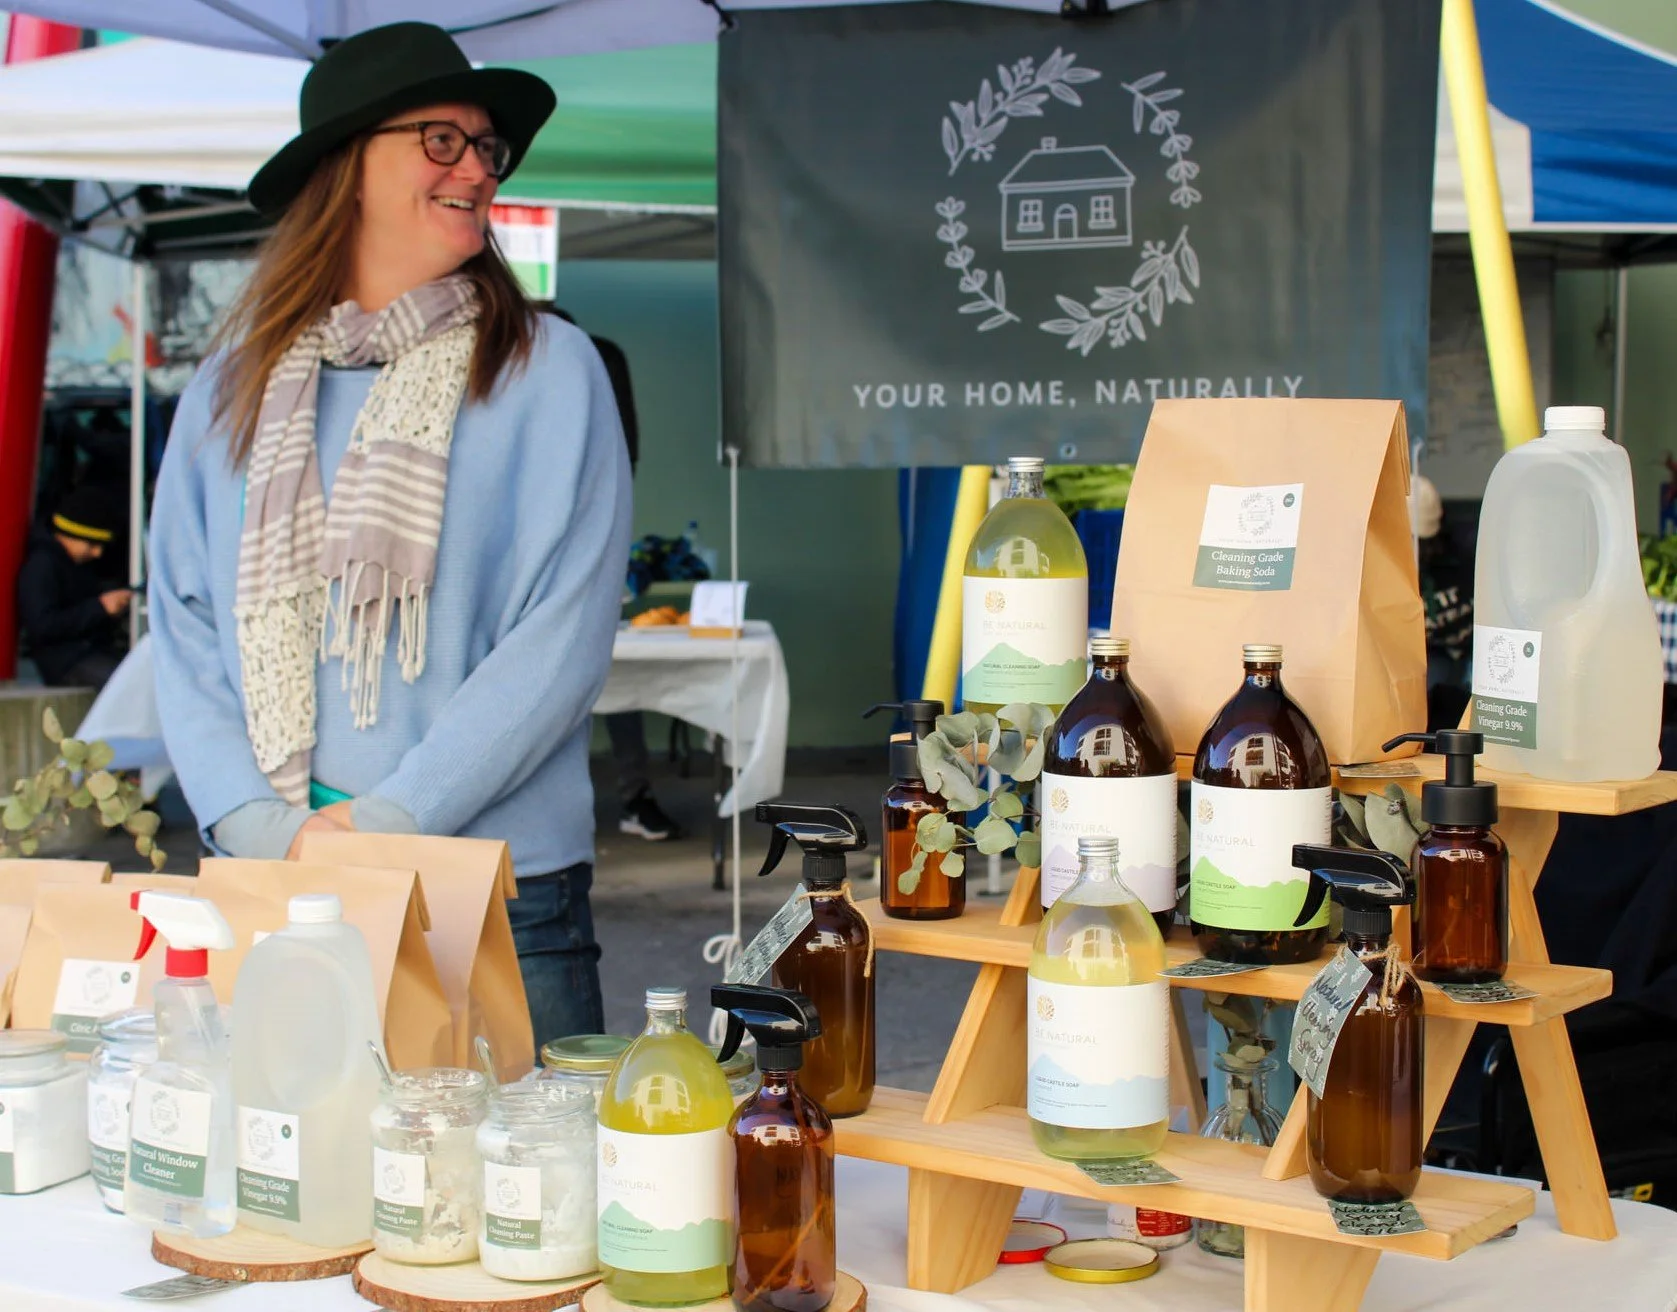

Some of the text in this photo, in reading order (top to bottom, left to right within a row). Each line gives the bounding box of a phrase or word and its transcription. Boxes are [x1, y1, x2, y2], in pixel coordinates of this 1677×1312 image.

[853, 376, 1303, 409] YOUR HOME, NATURALLY
[1211, 550, 1284, 565] Cleaning Grade
[1216, 565, 1275, 579] Baking Soda
[998, 620, 1047, 630] NATURAL
[1476, 700, 1528, 717] Cleaning Grade
[1478, 715, 1524, 732] Vinegar 9.9%
[1062, 822, 1112, 835] NATURAL
[1206, 833, 1256, 847] NATURAL
[1312, 974, 1355, 1013] Natural
[1302, 1000, 1336, 1050] Cleaning
[1046, 1031, 1098, 1045] NATURAL
[1297, 1028, 1324, 1082] Spray
[158, 1151, 198, 1169] Window
[143, 1162, 176, 1179] Cleaner
[240, 1172, 268, 1190] Cleaning
[611, 1177, 661, 1192] NATURAL
[383, 1203, 406, 1215] Natural
[399, 1216, 418, 1226] Paste
[497, 1218, 522, 1229] Natural
[488, 1225, 514, 1240] Cleaning
[515, 1231, 536, 1241] Paste
